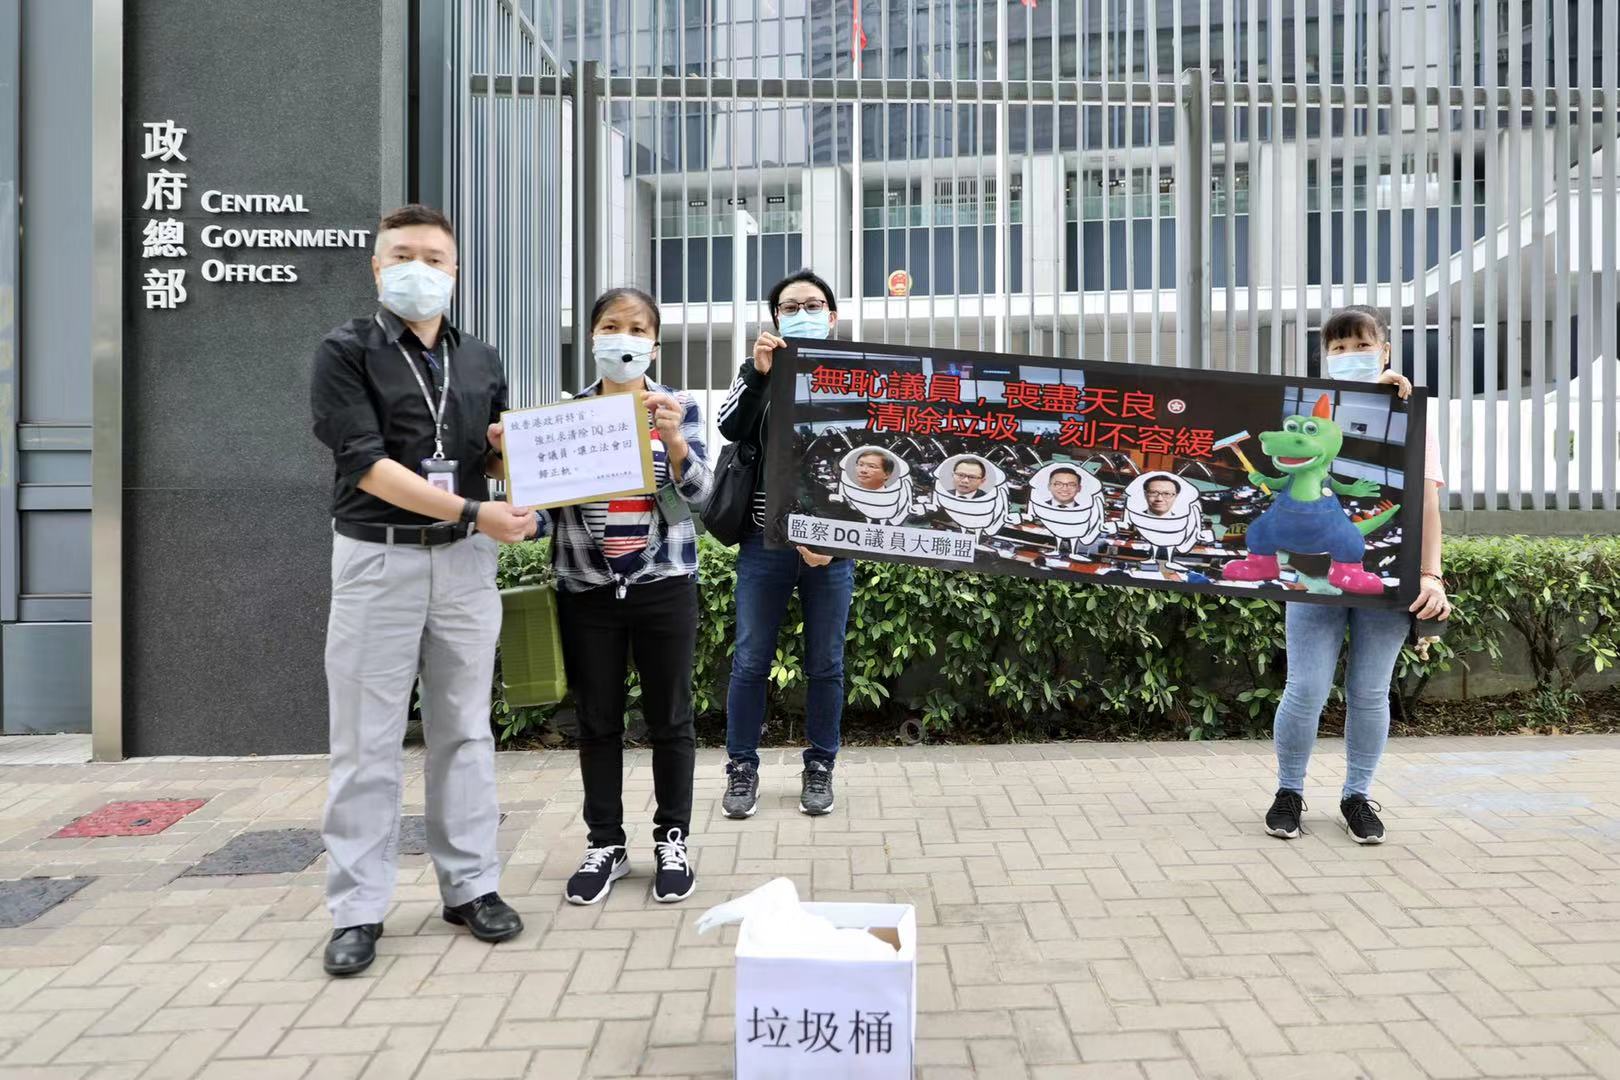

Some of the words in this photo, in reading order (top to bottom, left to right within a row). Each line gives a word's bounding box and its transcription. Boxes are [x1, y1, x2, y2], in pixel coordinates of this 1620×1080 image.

[141, 119, 188, 309] 政府總部
[201, 189, 309, 213] CENTRAL
[201, 224, 371, 249] GOVERNMENT
[201, 258, 299, 283] OFFICES
[866, 402, 1215, 458] 清除垃圾，刻不容緩
[746, 1006, 893, 1055] 垃圾桶
